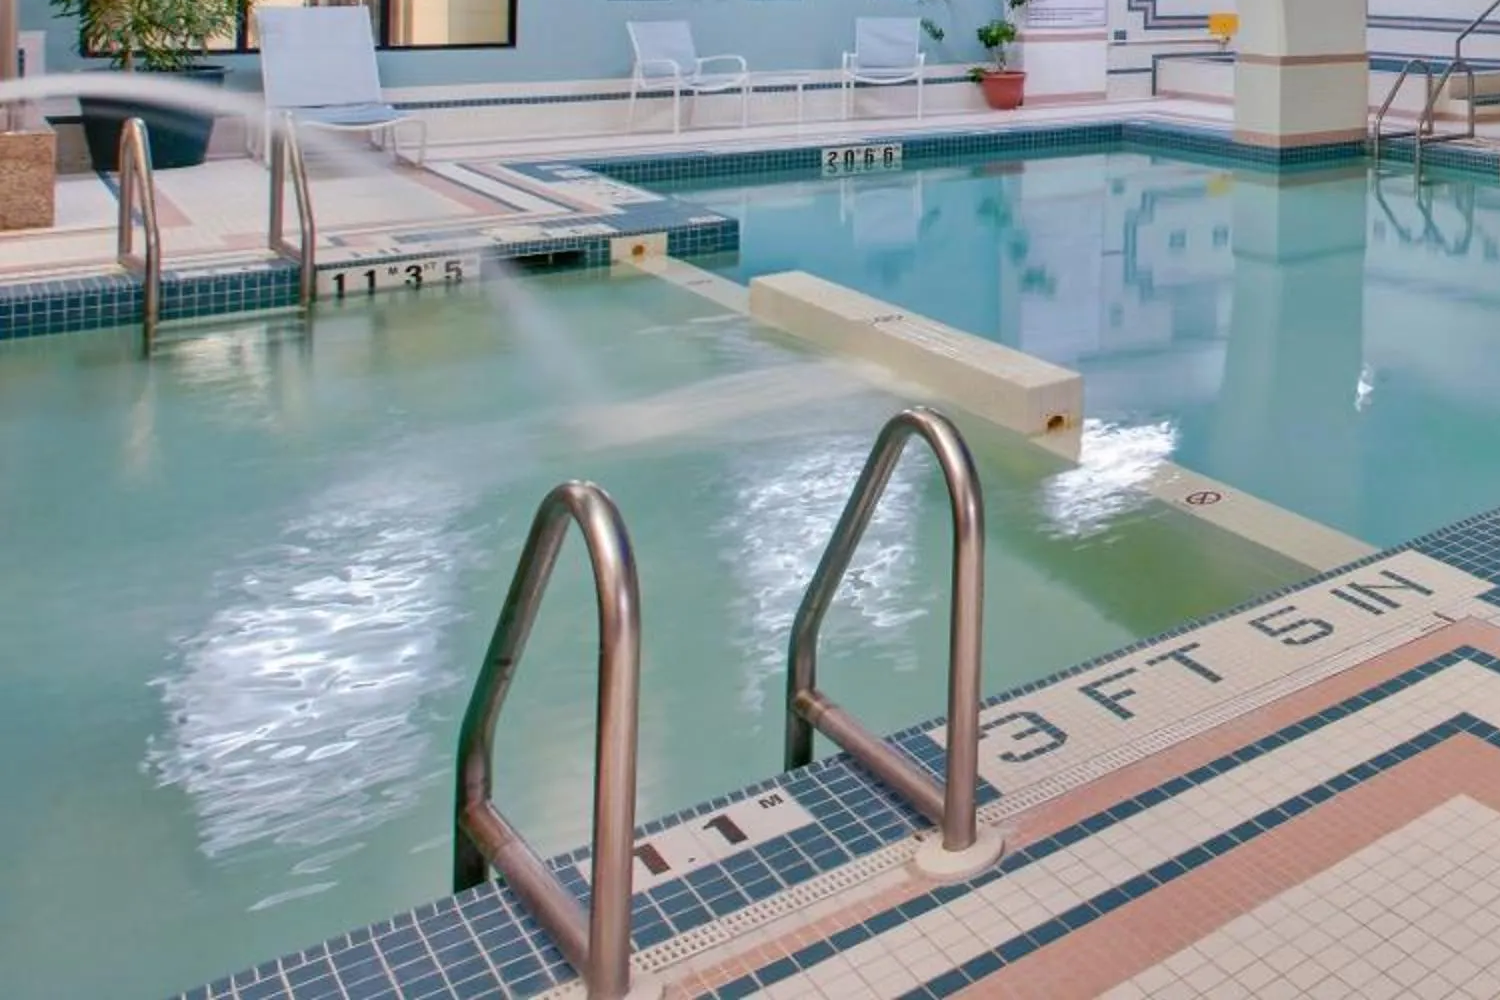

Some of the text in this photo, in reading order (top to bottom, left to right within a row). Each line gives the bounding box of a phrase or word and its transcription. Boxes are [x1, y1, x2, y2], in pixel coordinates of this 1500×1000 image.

[977, 570, 1434, 762] 3 FT 5 IN
